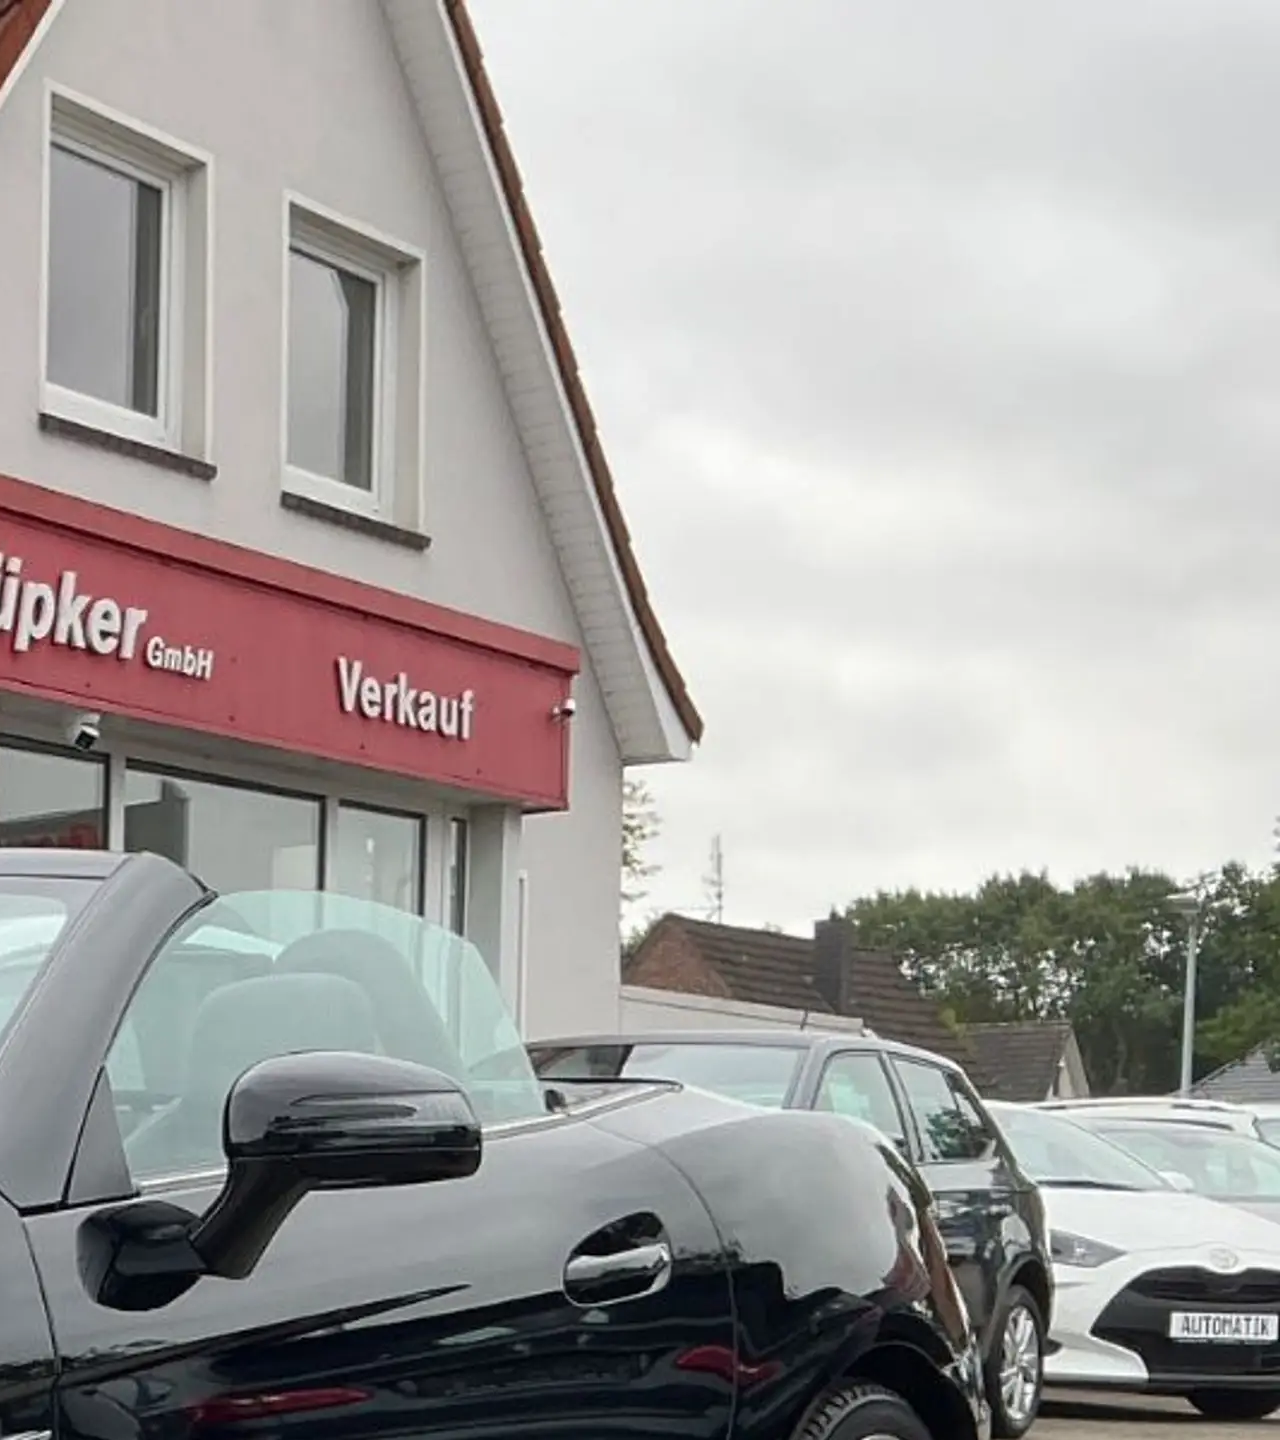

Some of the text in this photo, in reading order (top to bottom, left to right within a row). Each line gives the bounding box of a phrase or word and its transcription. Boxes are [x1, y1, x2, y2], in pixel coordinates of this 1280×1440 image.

[146, 635, 214, 680] GmbH
[338, 657, 474, 740] Verkauf
[1181, 1315, 1269, 1336] AUTOMATIK
